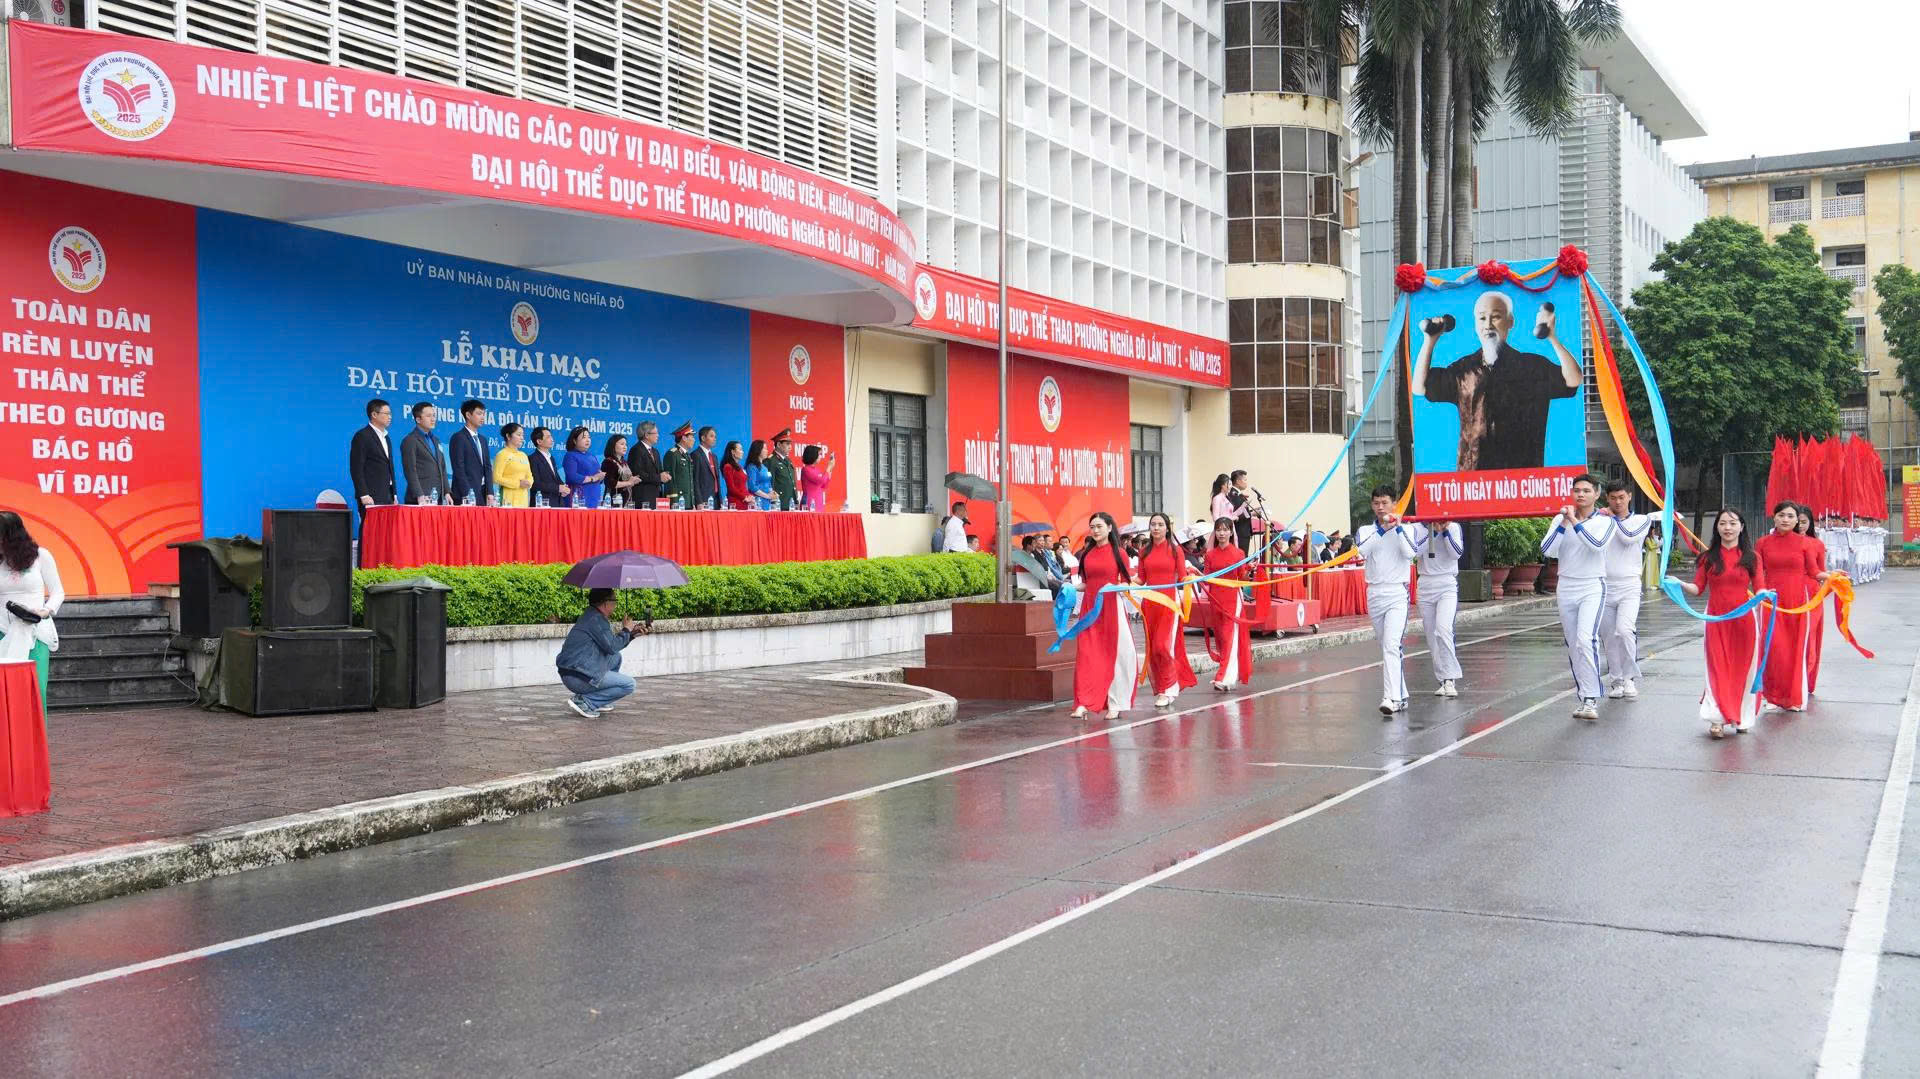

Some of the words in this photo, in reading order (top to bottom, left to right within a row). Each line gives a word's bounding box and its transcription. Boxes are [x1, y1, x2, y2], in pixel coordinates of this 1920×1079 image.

[54, 16, 64, 26] LG
[116, 112, 141, 123] 2025
[197, 64, 288, 108] NHIỆT
[297, 76, 356, 118] LIỆT
[365, 88, 437, 126] CHÀO
[446, 100, 520, 140] MỪNG
[527, 114, 572, 149] CÁC
[579, 127, 619, 158] QUÝ
[625, 135, 643, 168] VỊ
[648, 140, 679, 174] ĐẠI
[684, 144, 725, 184] BIỂU,
[728, 158, 758, 192] VẬN
[761, 168, 796, 200] ĐỘNG
[798, 181, 827, 214] VIÊN,
[829, 191, 854, 220] HUẤN
[856, 205, 880, 235] LUYỆN
[471, 153, 512, 190] ĐẠI
[520, 158, 558, 197] HỘI
[564, 163, 604, 199] THỂ
[610, 176, 649, 210] DỤC
[654, 180, 687, 214] THỂ
[690, 192, 730, 226] THAO
[734, 203, 788, 238] PHƯỜNG
[792, 218, 826, 249] NGHĨA
[828, 229, 841, 254] ĐÔ
[407, 259, 424, 276] UỶ
[428, 265, 455, 282] BAN
[458, 271, 492, 288] NHÂN
[496, 276, 520, 293] DÂN
[523, 282, 571, 301] PHƯỜNG
[573, 290, 607, 308] NGHĨA
[609, 294, 625, 310] ĐÔ
[12, 298, 87, 326] TOÀN
[96, 308, 150, 333] DÂN
[2, 330, 60, 357] RÈN
[70, 338, 153, 367] LUYỆN
[945, 291, 965, 328] ĐẠI
[968, 294, 986, 332] HỘI
[988, 301, 1000, 330] TH
[1008, 306, 1029, 341] DỤC
[1030, 304, 1049, 340] THỂ
[1050, 316, 1073, 345] THAO
[1074, 321, 1108, 352] PHƯỜNG
[1110, 330, 1134, 359] NGHĨA
[1135, 333, 1146, 361] ĐÔ
[1163, 340, 1177, 367] THỨ
[1177, 345, 1182, 368] I
[1190, 346, 1205, 373] NĂM
[1206, 354, 1221, 376] 2025
[441, 330, 474, 366] LỄ
[480, 343, 545, 375] KHAI
[550, 352, 601, 383] MẠC
[14, 367, 88, 392] THÂN
[98, 370, 146, 397] THỂ
[347, 366, 398, 396] ĐẠI
[406, 370, 455, 400] HỘI
[461, 372, 510, 401] THỂ
[516, 383, 563, 410] DỤC
[568, 383, 611, 412] THỂ
[616, 394, 671, 415] THAO
[0, 402, 65, 425] THEO
[75, 406, 165, 431] GƯƠNG
[790, 392, 814, 411] KHỎE
[498, 411, 514, 426] ĐÔ
[517, 410, 539, 429] LẦN
[542, 414, 563, 433] THỨ
[582, 418, 606, 433] NĂM
[609, 421, 633, 435] 2025
[32, 435, 89, 461] BÁC
[98, 436, 133, 462] HỒ
[965, 432, 988, 480] ĐOÀN
[989, 429, 1000, 483] KẾ
[1010, 443, 1034, 485] TRUNG
[1036, 443, 1054, 495] THỰC
[1059, 448, 1072, 487] CAO
[37, 470, 64, 494] VĨ
[73, 473, 129, 499] ĐẠI!
[1444, 479, 1460, 502] TÔI
[1464, 477, 1492, 500] NGÀY
[1495, 476, 1518, 499] NÀO
[1521, 475, 1550, 499] CŨNG
